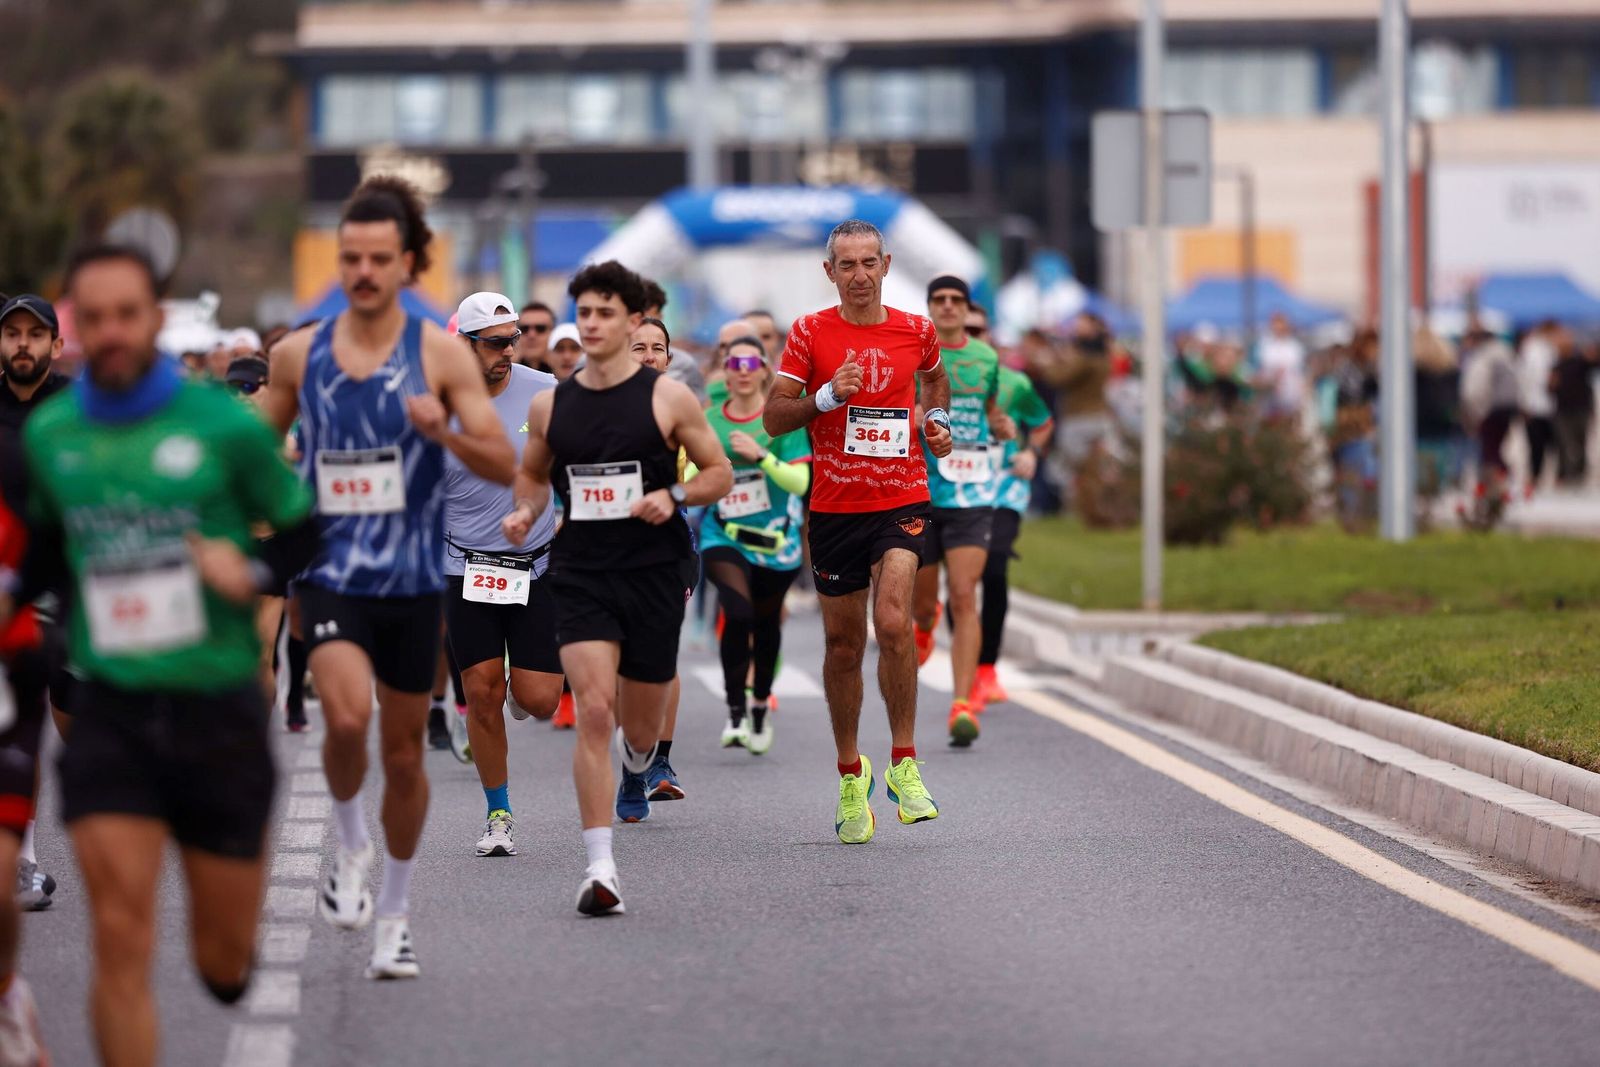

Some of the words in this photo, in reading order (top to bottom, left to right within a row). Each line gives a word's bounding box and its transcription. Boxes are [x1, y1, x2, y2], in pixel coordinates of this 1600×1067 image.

[854, 428, 890, 442] 364
[948, 459, 974, 470] 724
[582, 488, 614, 502] 718
[473, 574, 508, 591] 239
